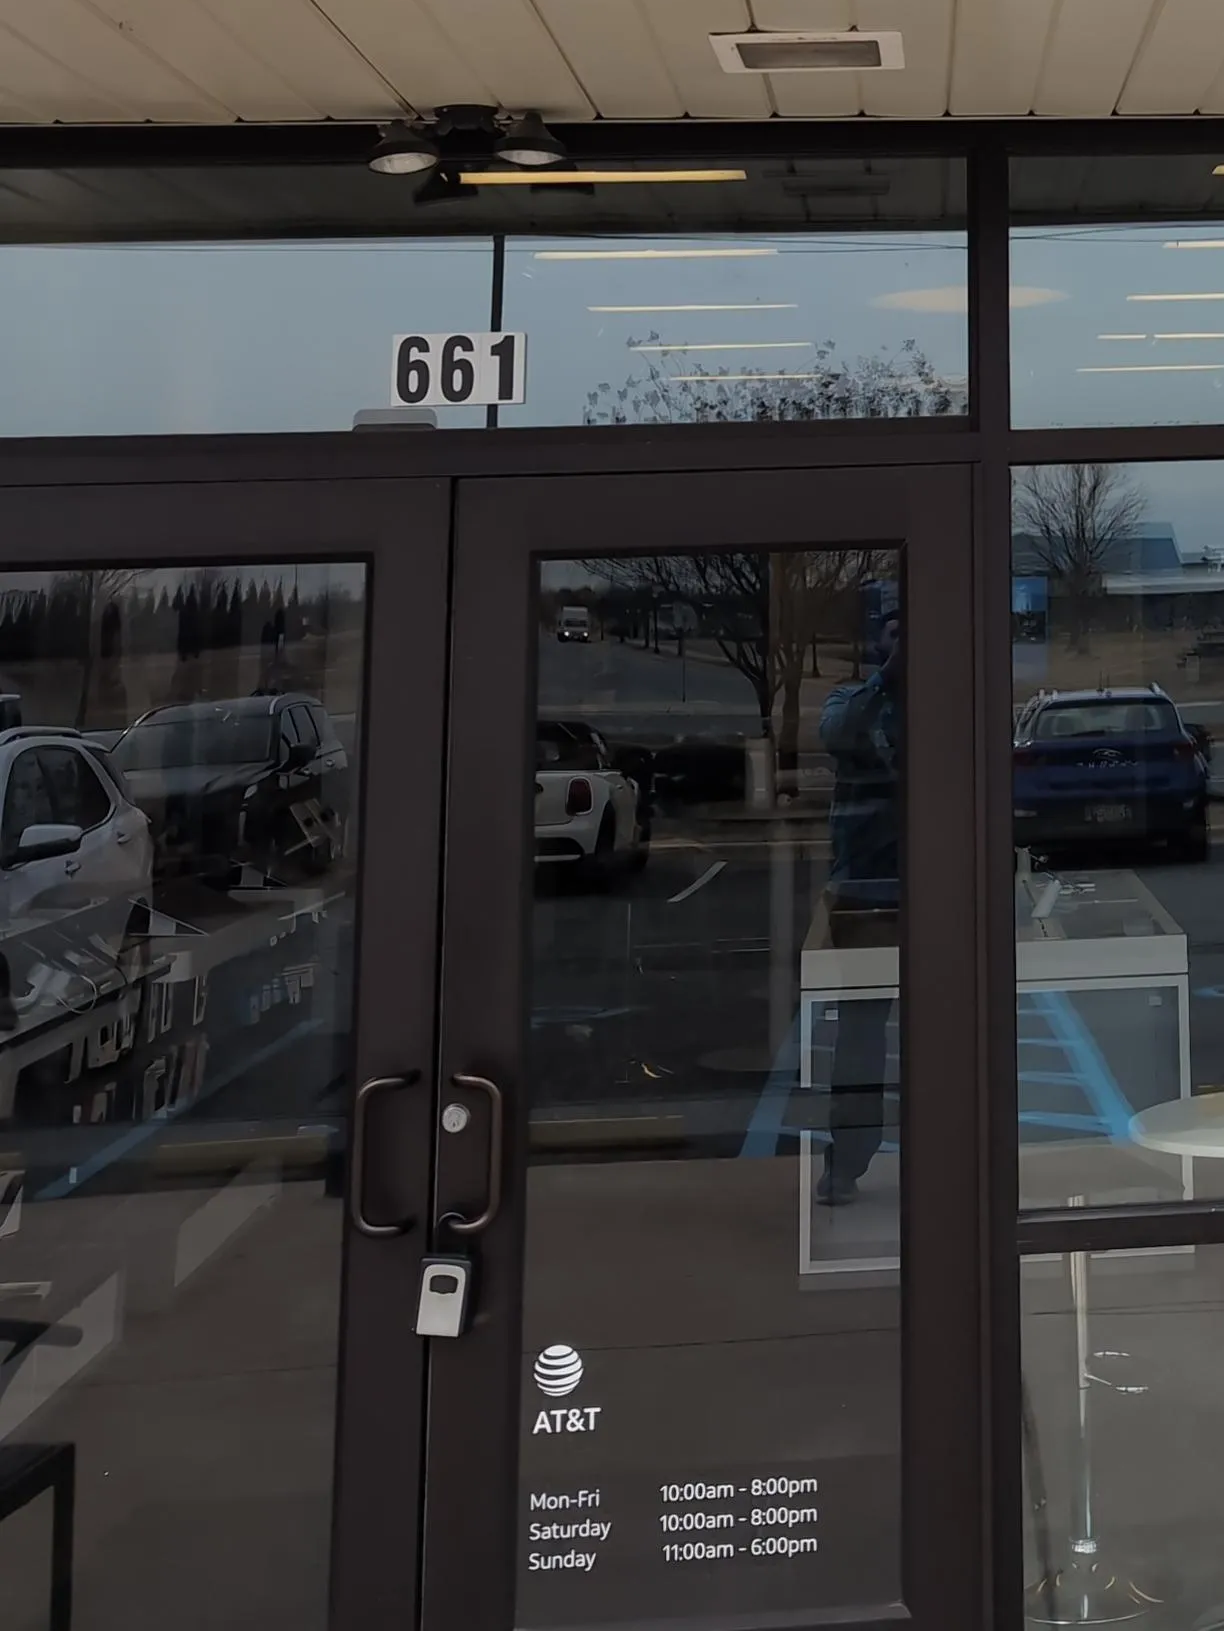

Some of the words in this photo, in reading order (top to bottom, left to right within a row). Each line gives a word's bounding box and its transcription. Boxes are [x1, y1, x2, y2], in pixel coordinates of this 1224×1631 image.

[397, 335, 515, 403] 661
[532, 1407, 601, 1434] AT&T
[530, 1489, 601, 1511] Mon-Fri
[659, 1483, 734, 1502] 10:00am
[751, 1477, 818, 1499] 8:00pm
[529, 1518, 612, 1541] Saturday
[659, 1513, 734, 1532] 10:00am
[751, 1507, 818, 1528] 8:00pm
[528, 1549, 597, 1571] Sunday
[662, 1543, 734, 1562] 11:00am
[751, 1537, 818, 1558] 6:00pm
